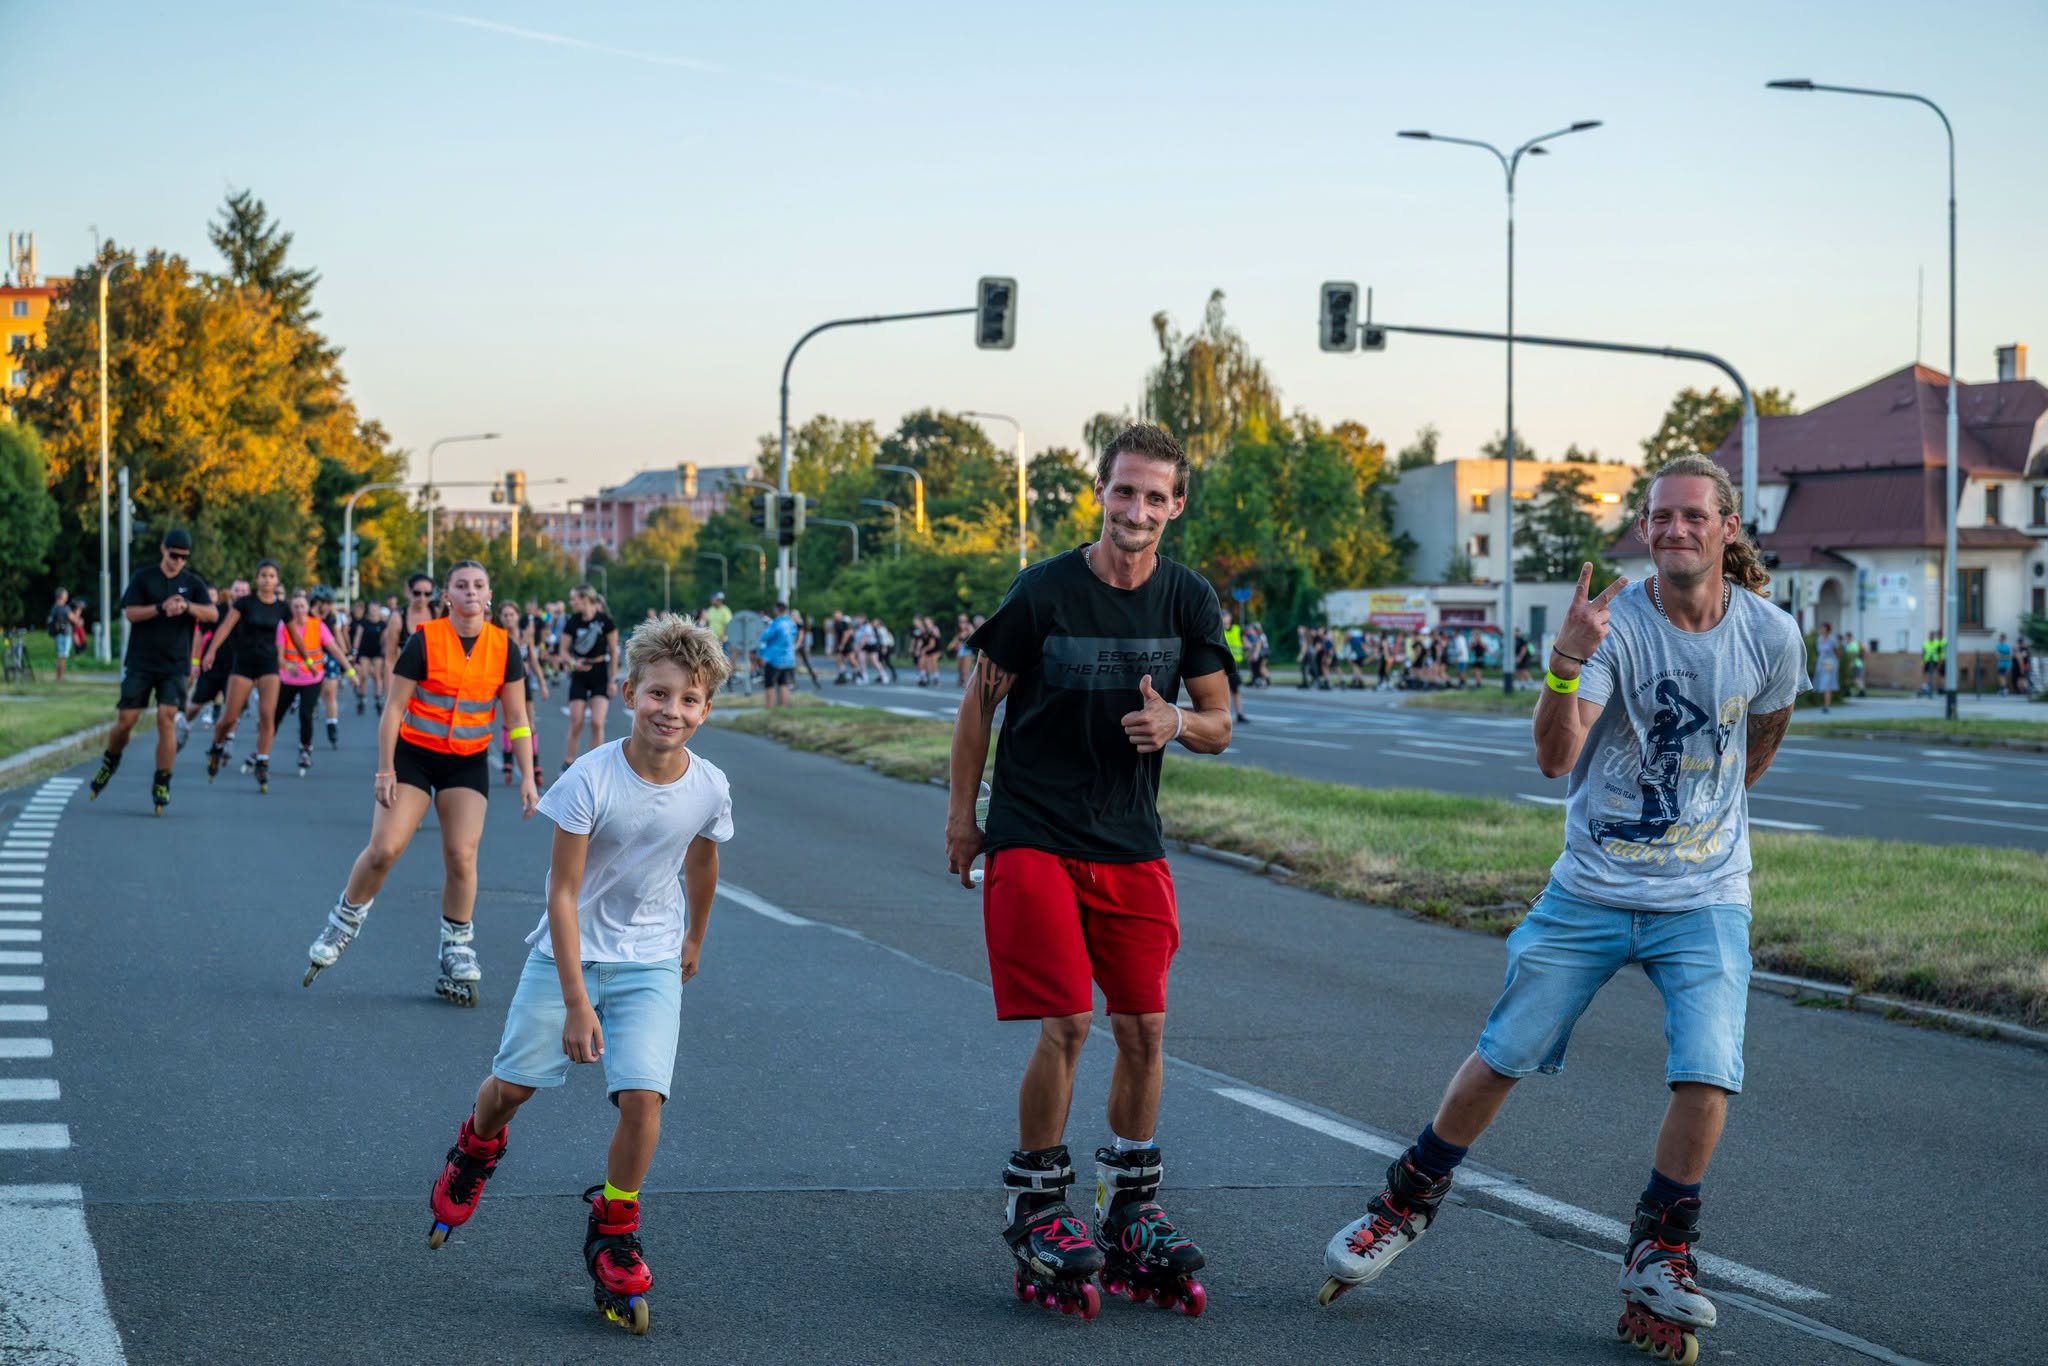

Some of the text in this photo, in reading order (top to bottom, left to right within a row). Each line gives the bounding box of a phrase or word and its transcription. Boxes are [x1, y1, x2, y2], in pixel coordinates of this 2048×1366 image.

[1097, 651, 1175, 662] ESCAPE
[1056, 663, 1174, 676] THE REALITY
[1630, 669, 1699, 699] NTERNATIONAL LEAGUE
[1604, 782, 1637, 801] SPORTS TEAM
[1699, 800, 1721, 813] MVP
